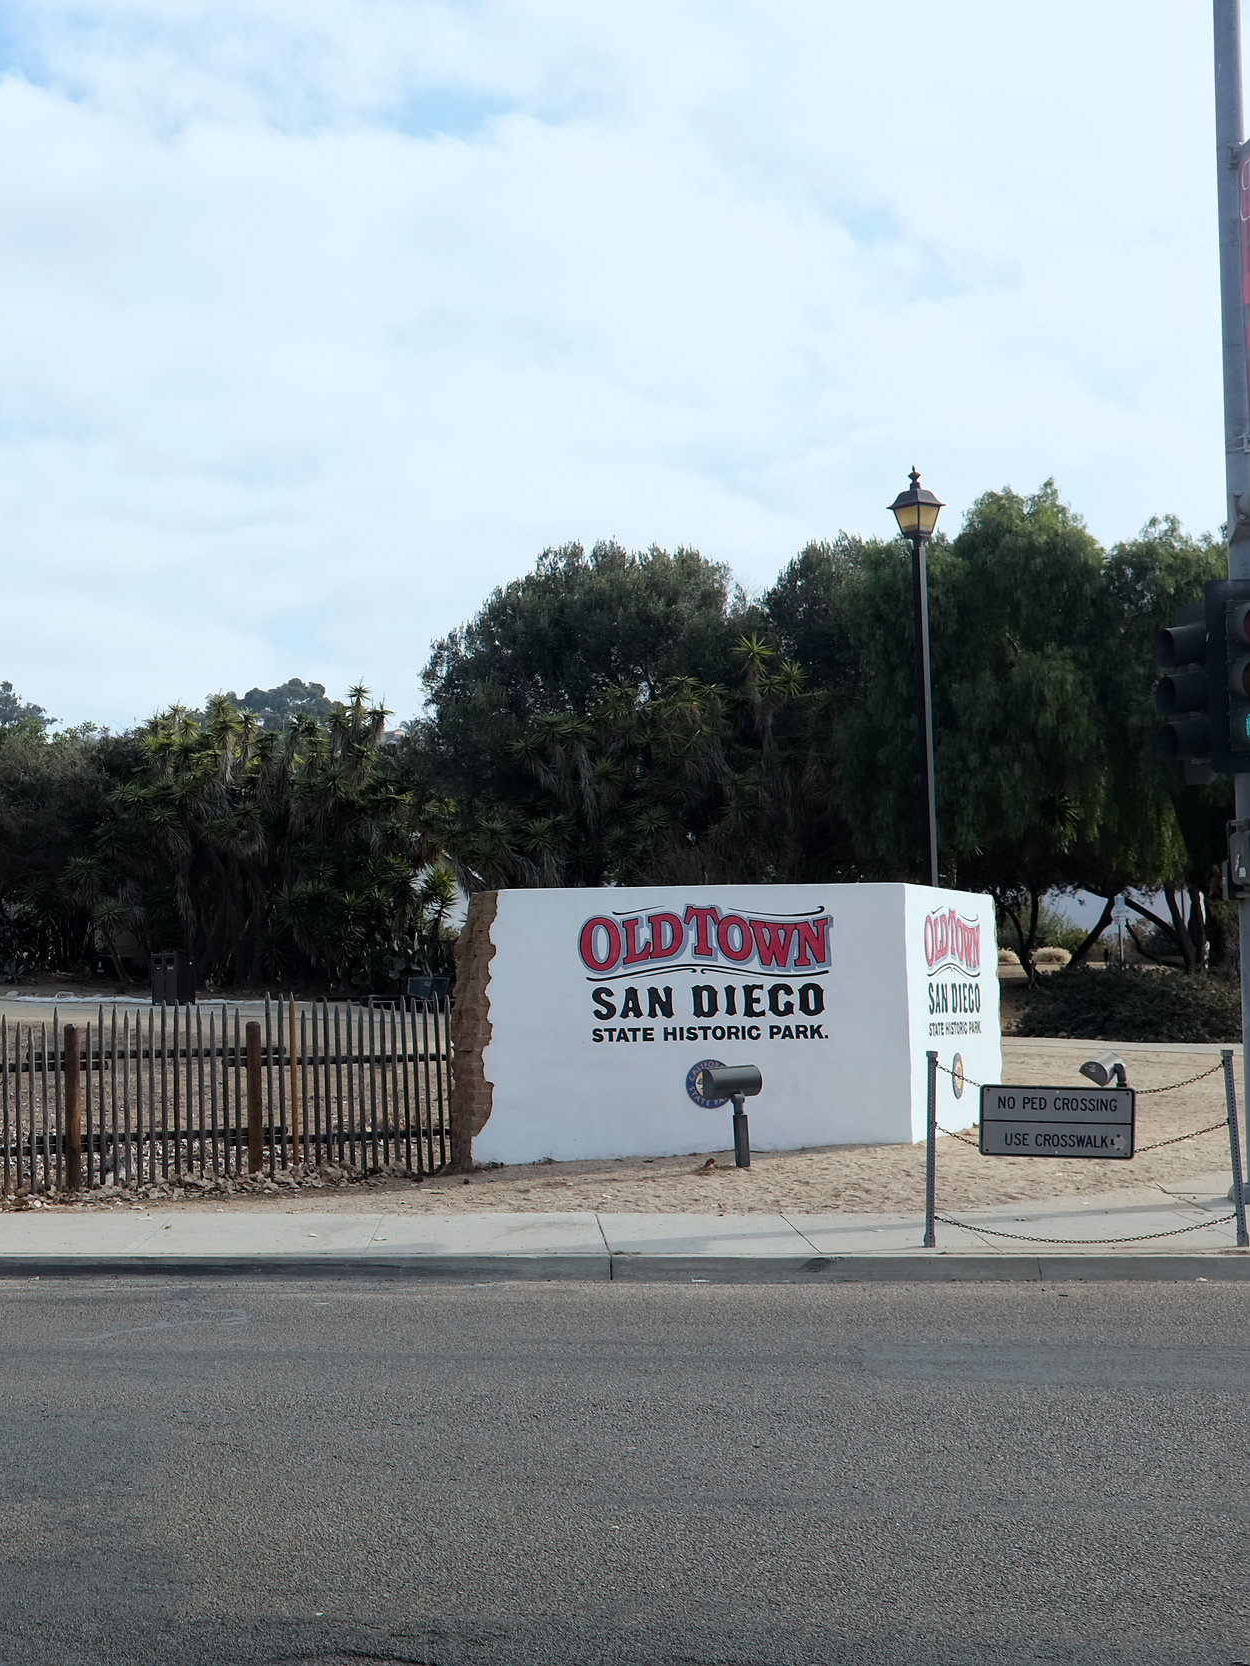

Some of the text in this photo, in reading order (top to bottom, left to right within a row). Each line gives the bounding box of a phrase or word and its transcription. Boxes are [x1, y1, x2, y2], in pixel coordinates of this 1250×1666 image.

[579, 904, 833, 976] OLD TOWN
[924, 908, 981, 972] OLD TOWN
[591, 982, 826, 1020] SAN DIEGO
[928, 982, 981, 1015] SAN DIEGO
[591, 1024, 830, 1043] STATE HISTORIC PARK.
[928, 1022, 944, 1037] STATE
[945, 1021, 968, 1036] HISTORIC
[688, 1086, 710, 1106] STATE
[997, 1096, 1118, 1113] NO PED CROSSING
[1004, 1132, 1109, 1149] USE CROSSWALK
